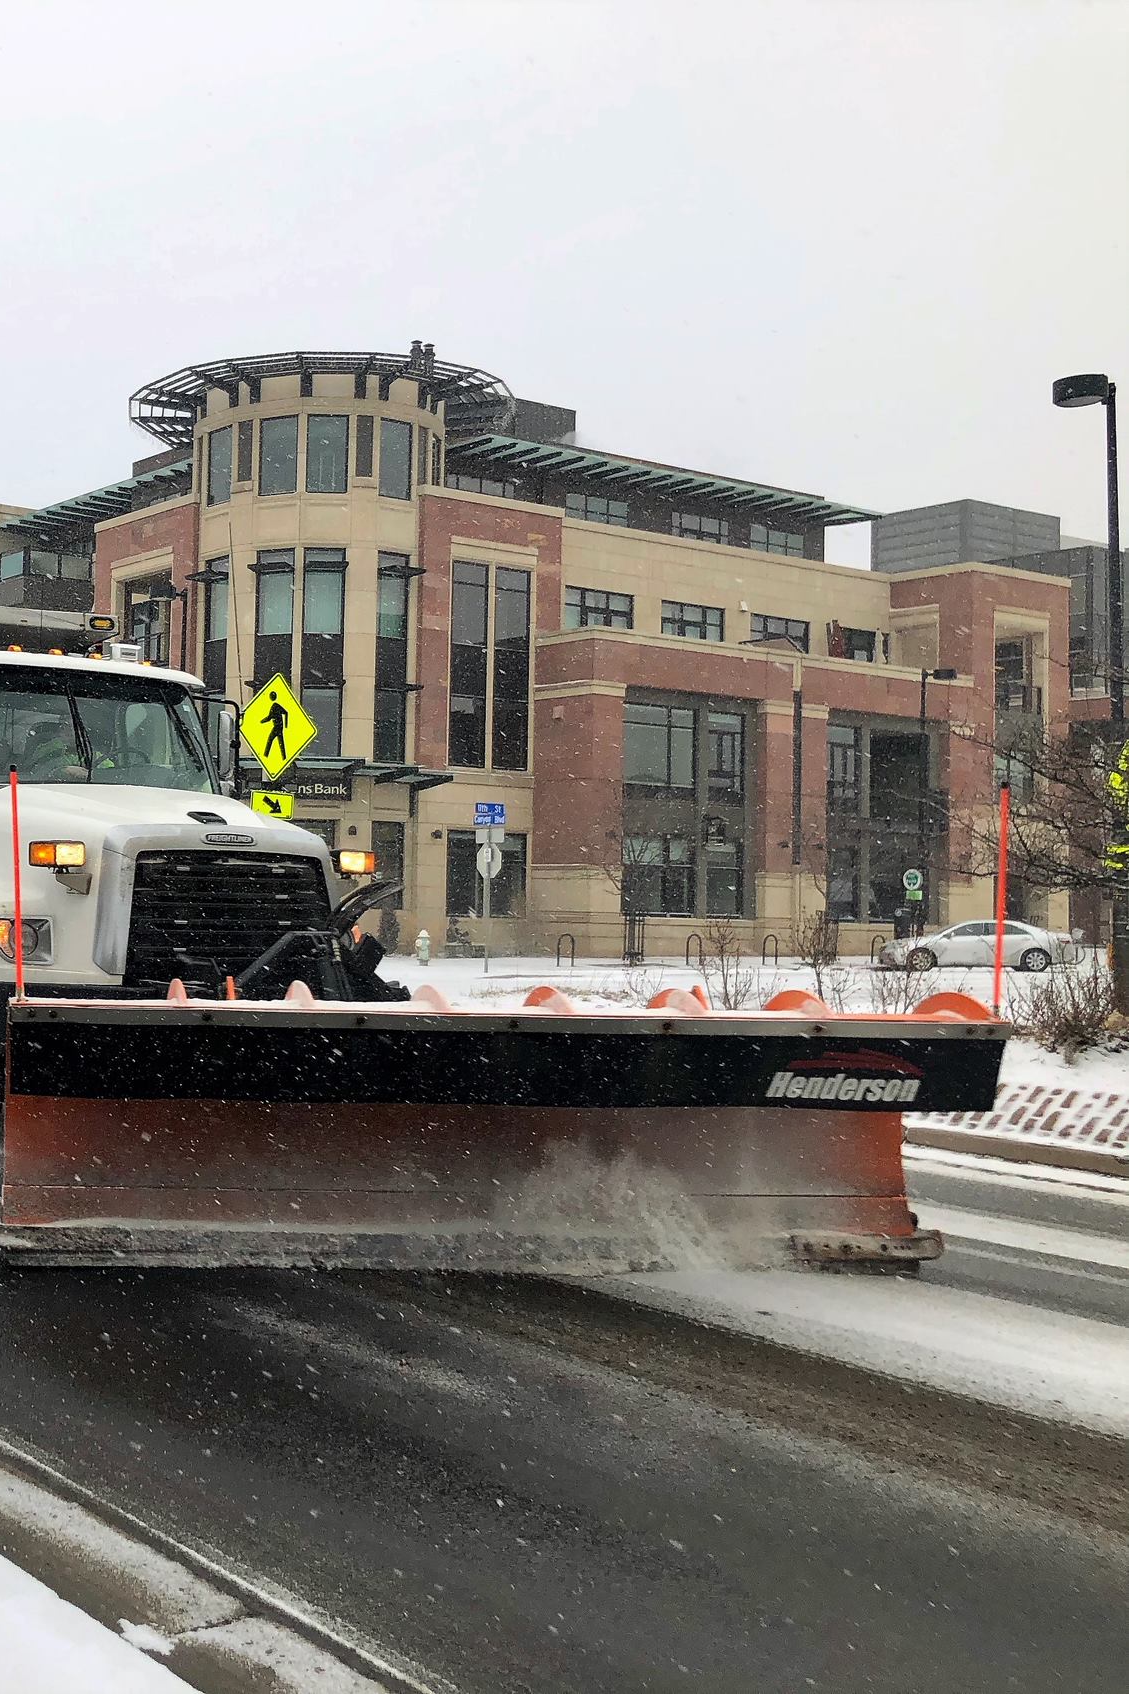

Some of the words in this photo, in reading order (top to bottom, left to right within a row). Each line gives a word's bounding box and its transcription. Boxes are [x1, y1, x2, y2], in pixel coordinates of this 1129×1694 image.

[314, 783, 347, 795] Bank
[494, 805, 502, 814] St
[494, 815, 505, 824] Blvd
[765, 1071, 920, 1102] Henderson
